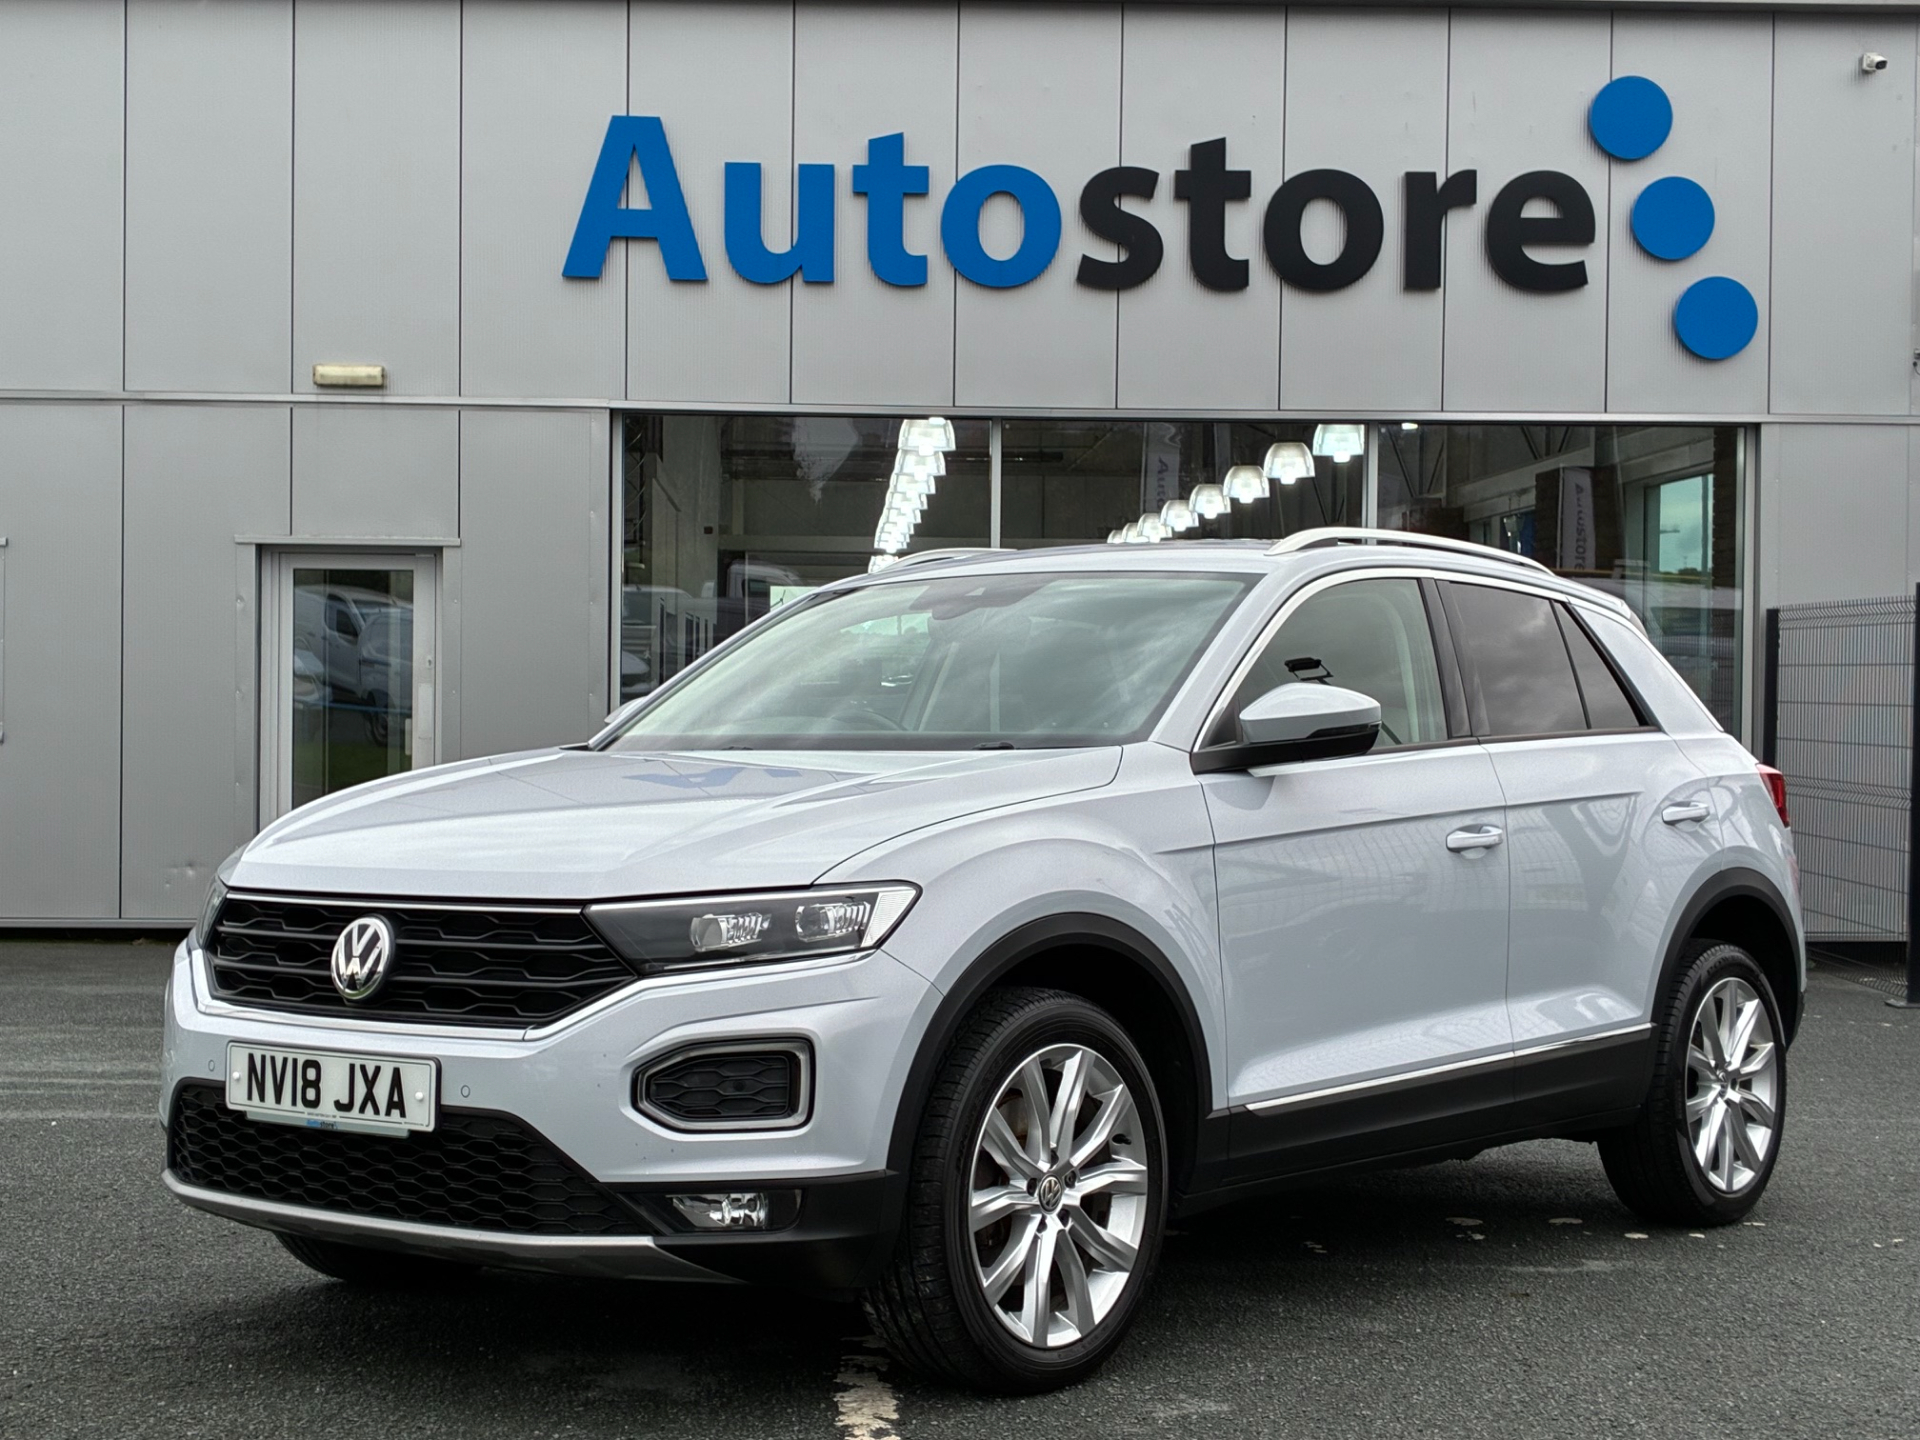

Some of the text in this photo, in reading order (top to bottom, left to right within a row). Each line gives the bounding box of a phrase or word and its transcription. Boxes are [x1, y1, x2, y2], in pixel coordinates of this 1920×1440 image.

[562, 115, 1597, 292] Autostore
[331, 917, 390, 999] VW
[246, 1052, 407, 1119] NV18 JXA
